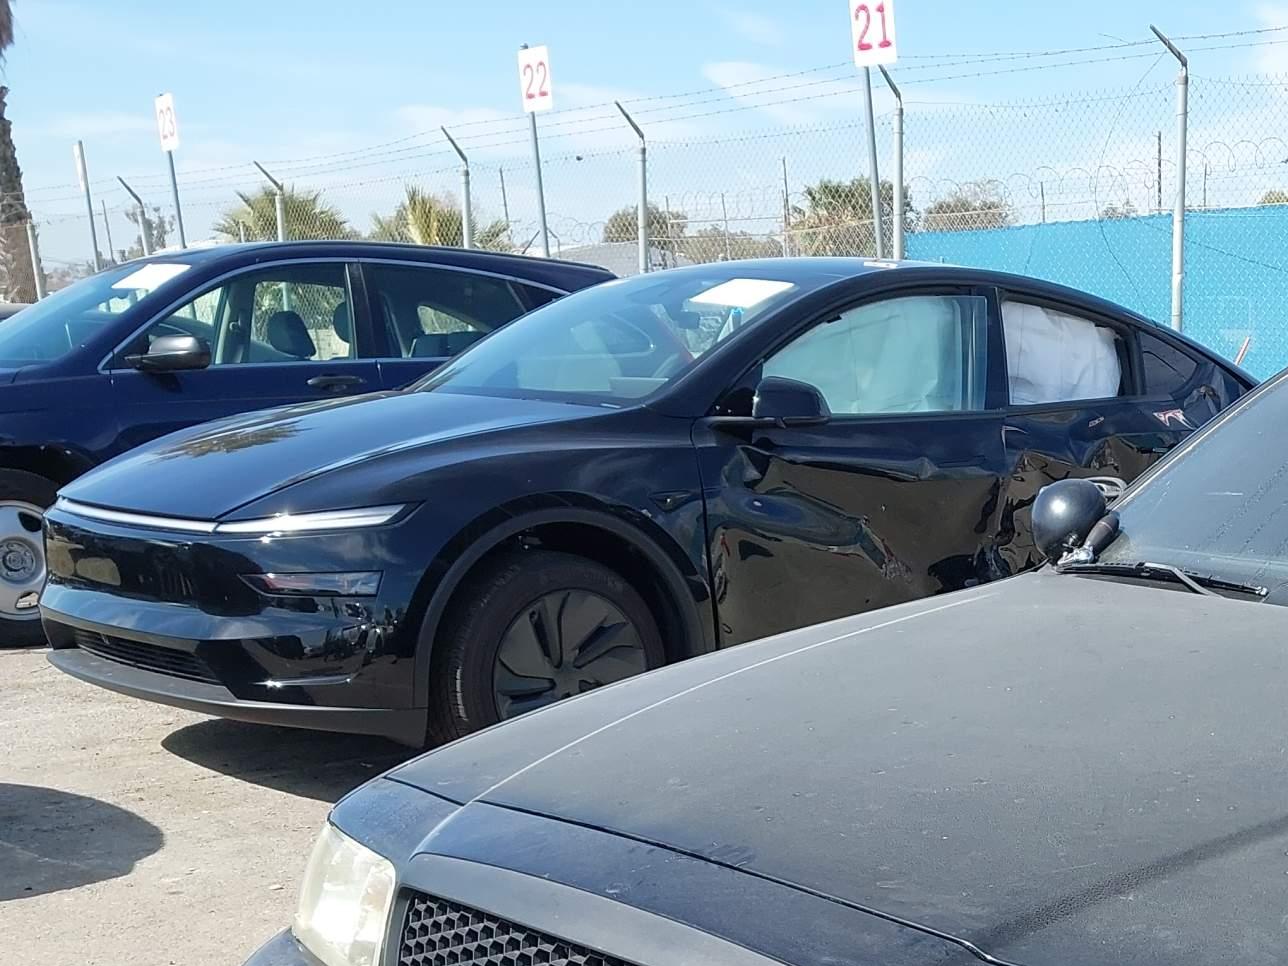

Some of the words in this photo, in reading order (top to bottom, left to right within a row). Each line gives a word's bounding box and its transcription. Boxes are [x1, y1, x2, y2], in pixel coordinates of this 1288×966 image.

[854, 4, 892, 51] 21
[523, 61, 548, 99] 22
[159, 106, 175, 140] 23
